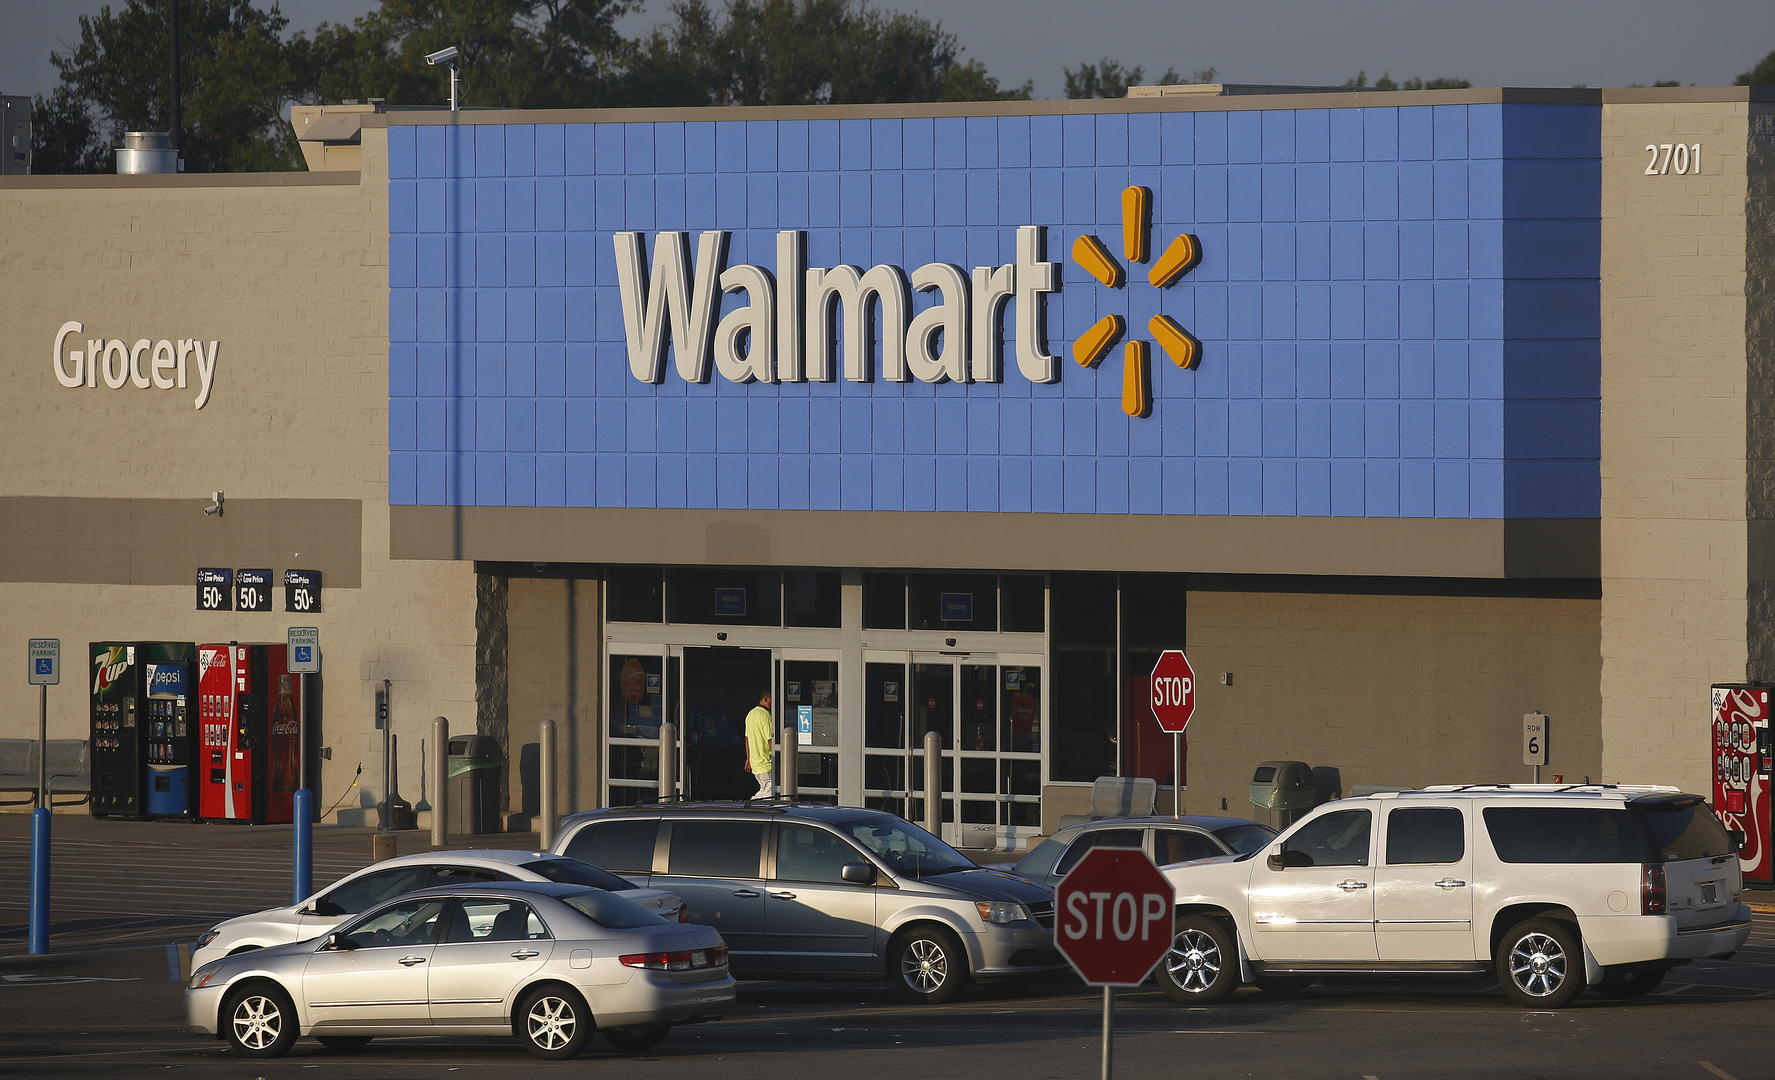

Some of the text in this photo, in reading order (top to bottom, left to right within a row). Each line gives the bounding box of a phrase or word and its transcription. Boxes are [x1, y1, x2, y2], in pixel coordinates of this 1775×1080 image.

[1645, 143, 1702, 175] 2701
[613, 225, 1060, 383] Walmart
[53, 320, 219, 410] Grocery
[30, 641, 59, 649] RESERVED
[31, 649, 57, 657] PARKING
[156, 669, 181, 686] pepsi
[1153, 677, 1192, 707] STOP
[379, 704, 388, 720] 5
[1527, 724, 1541, 732] ROW
[1528, 736, 1540, 755] 6
[1063, 891, 1167, 942] STOP
